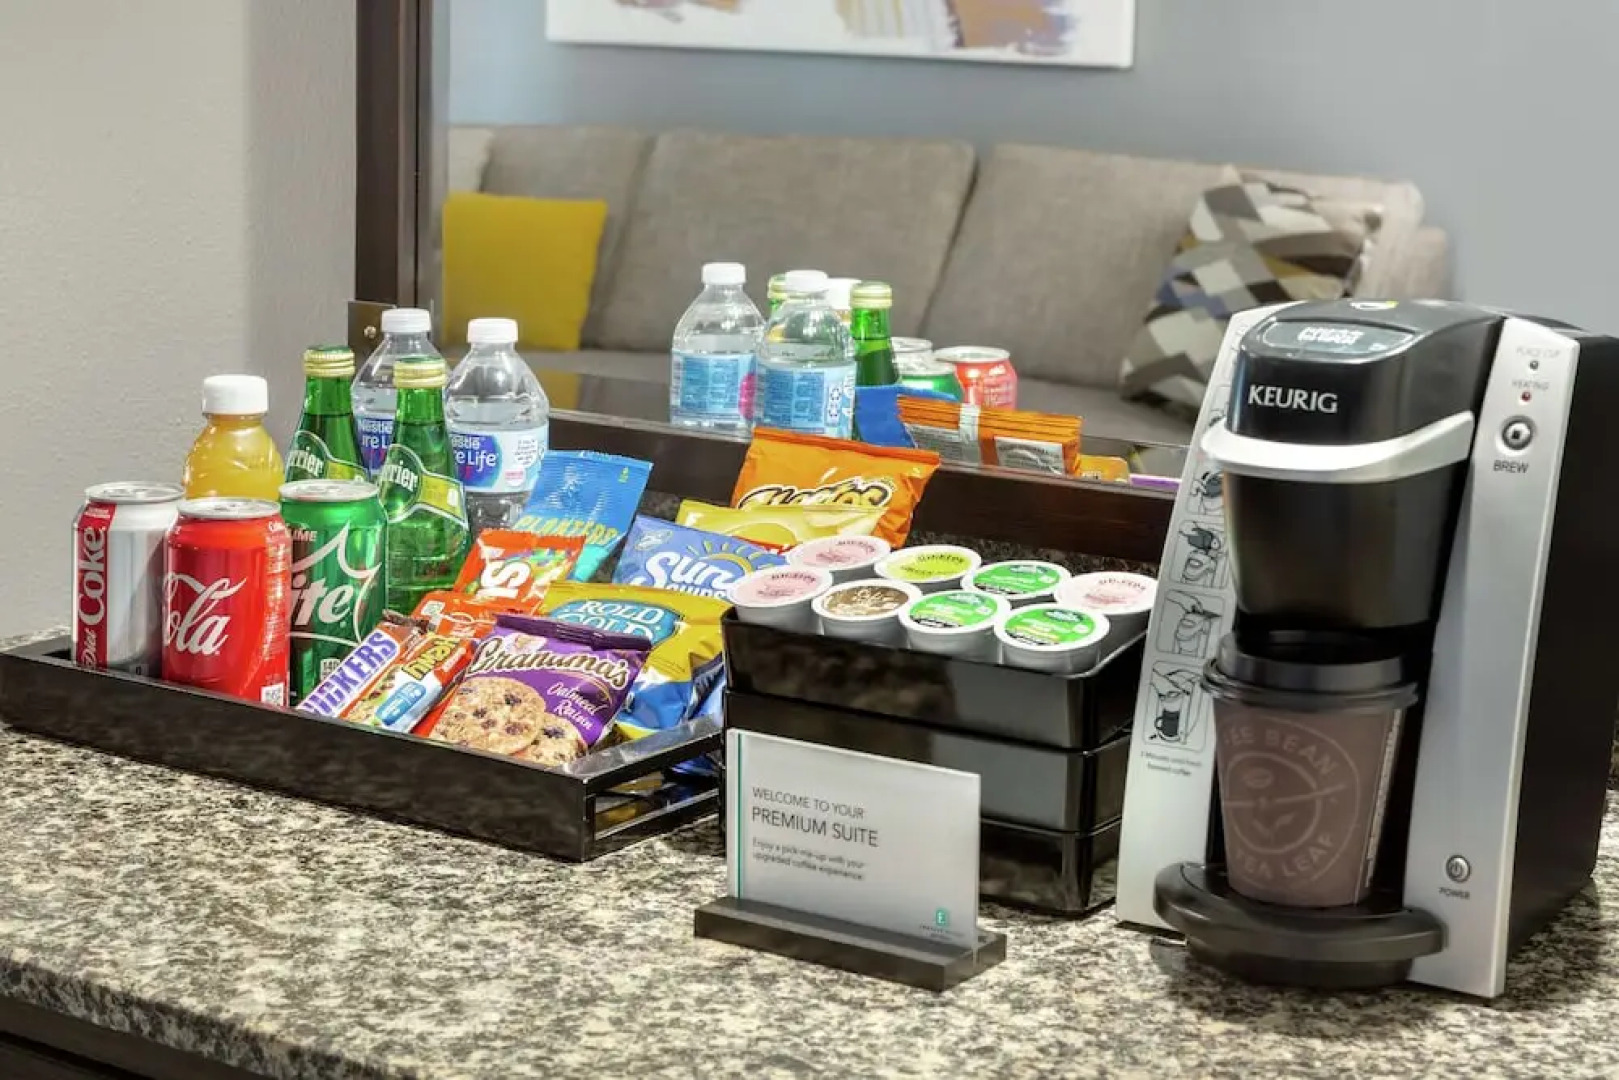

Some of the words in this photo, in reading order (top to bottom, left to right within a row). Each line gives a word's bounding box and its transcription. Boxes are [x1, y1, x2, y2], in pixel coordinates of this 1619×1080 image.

[1248, 384, 1338, 414] KEURIG
[1493, 459, 1529, 473] BREW
[78, 526, 105, 626] Coke
[645, 551, 737, 590] Sun
[578, 600, 665, 625] ROLD
[467, 635, 629, 690] Grandma's
[547, 683, 608, 715] Oatmeal
[752, 787, 811, 810] WELCOME
[813, 798, 830, 812] TO
[831, 802, 864, 819] YOUR
[752, 806, 827, 836] PREMIUM
[832, 822, 879, 848] SUITE
